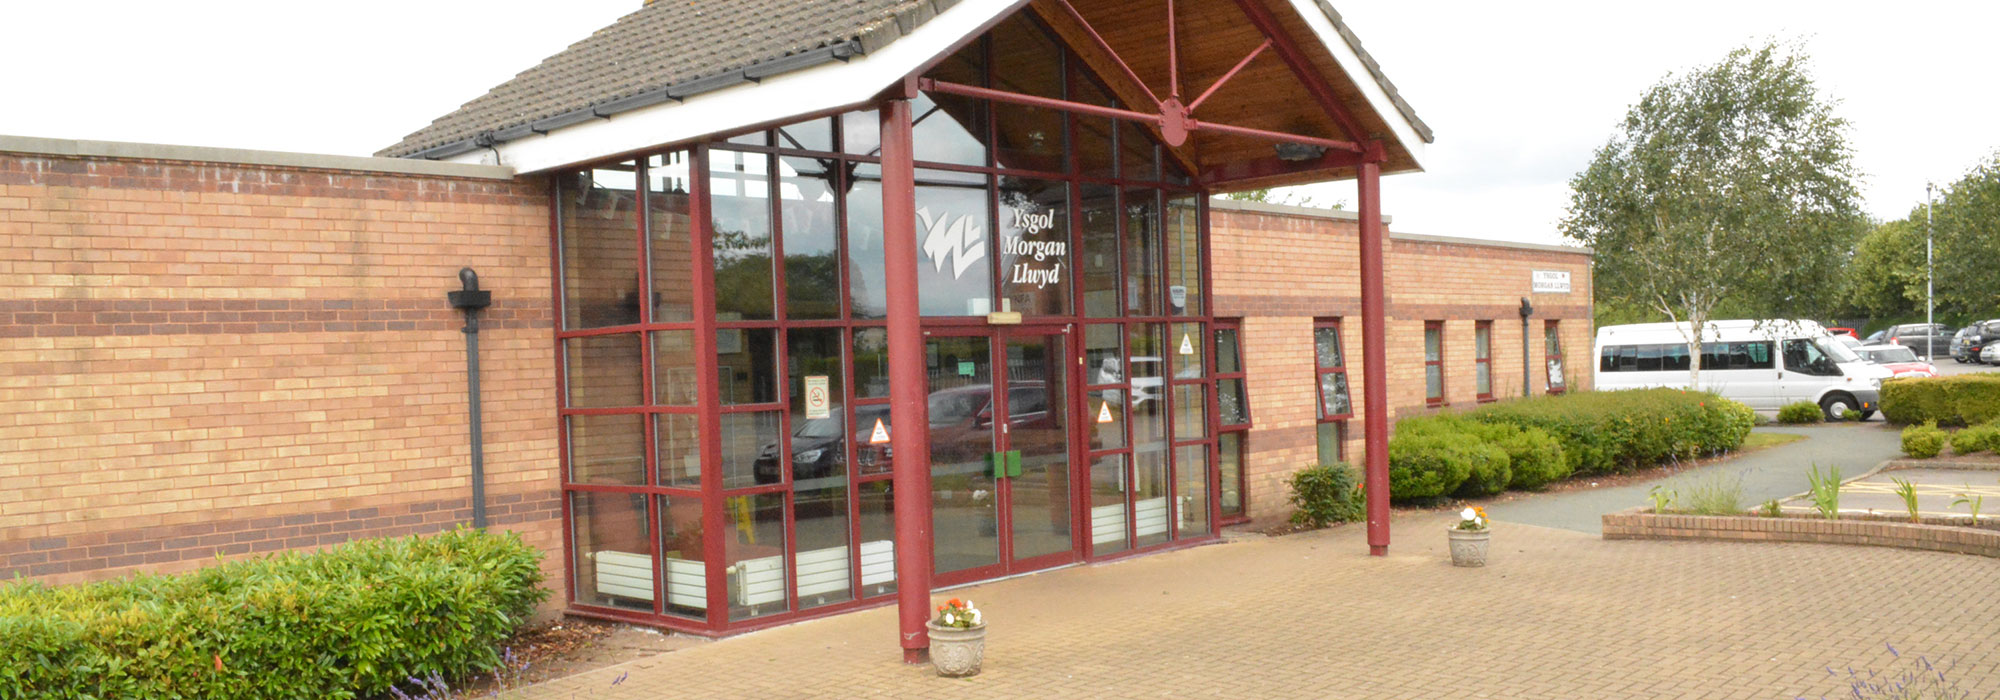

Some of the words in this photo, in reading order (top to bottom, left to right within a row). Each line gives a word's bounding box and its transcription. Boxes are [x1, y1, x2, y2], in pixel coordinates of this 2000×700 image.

[1013, 208, 1054, 235] Ysgol
[1003, 235, 1066, 262] Morgan
[1012, 263, 1060, 289] Llwyd
